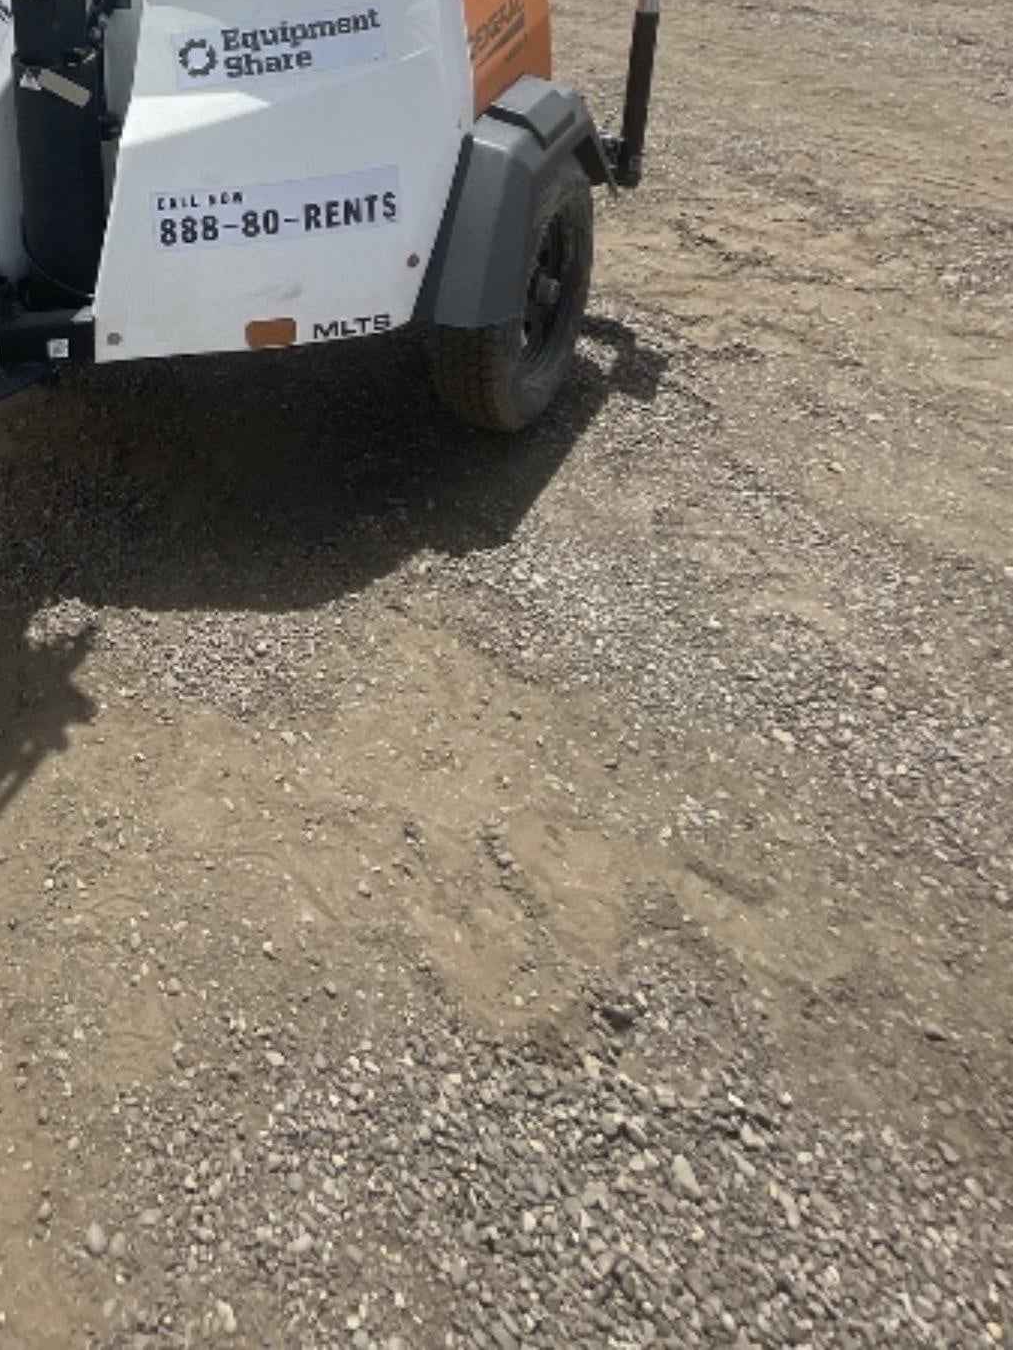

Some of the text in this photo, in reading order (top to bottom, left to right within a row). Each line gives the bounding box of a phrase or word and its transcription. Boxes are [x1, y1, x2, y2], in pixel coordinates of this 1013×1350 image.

[221, 9, 381, 51] Equipment
[223, 50, 313, 78] Share
[157, 194, 199, 211] CALL
[160, 191, 398, 246] 888-80-RENTS
